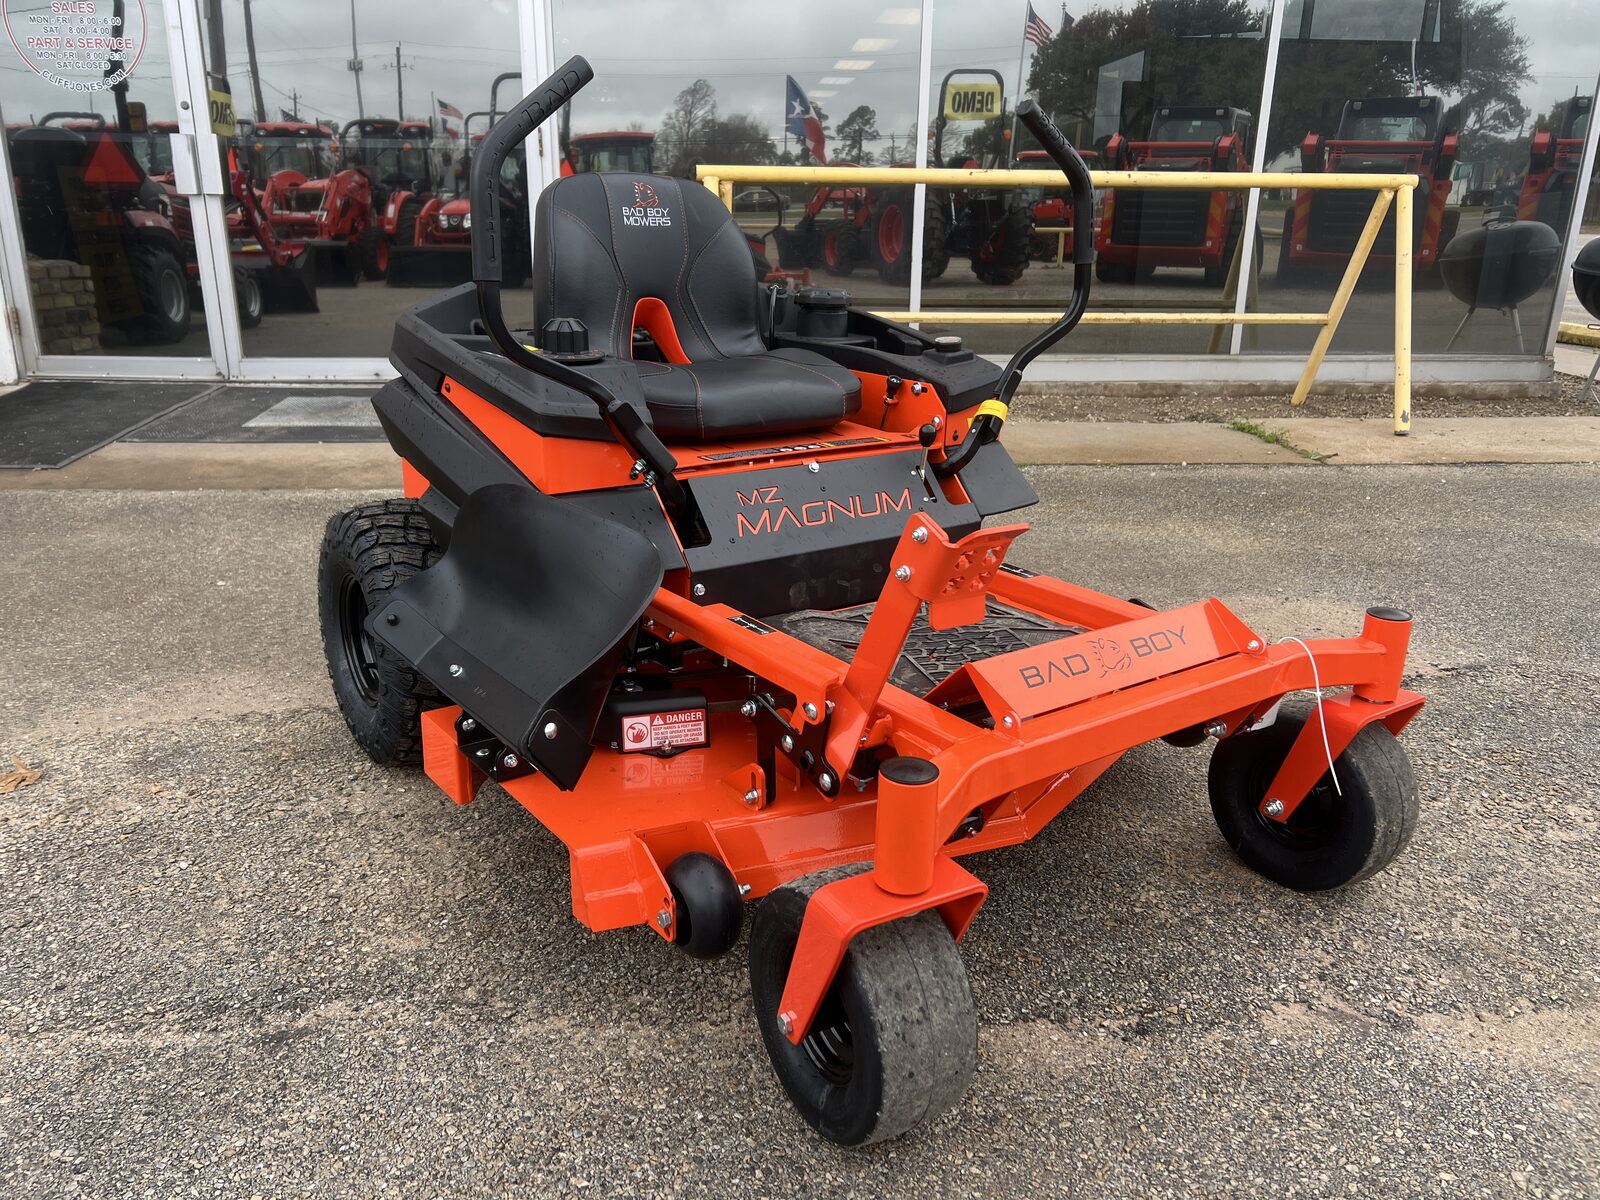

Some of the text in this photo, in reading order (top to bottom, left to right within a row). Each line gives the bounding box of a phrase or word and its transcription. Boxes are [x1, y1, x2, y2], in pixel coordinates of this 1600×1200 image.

[51, 3, 95, 13] SALES
[29, 16, 49, 24] MON
[27, 37, 133, 49] PART & SERVICE
[57, 61, 73, 69] SAT
[42, 69, 126, 91] CLIFFJONES.COM
[622, 206, 669, 217] BAD BOY
[623, 216, 671, 226] MOWERS
[736, 485, 784, 506] MZ
[736, 487, 913, 537] MAGNUM
[1018, 625, 1187, 689] BAD BOY
[666, 711, 702, 724] DANGER
